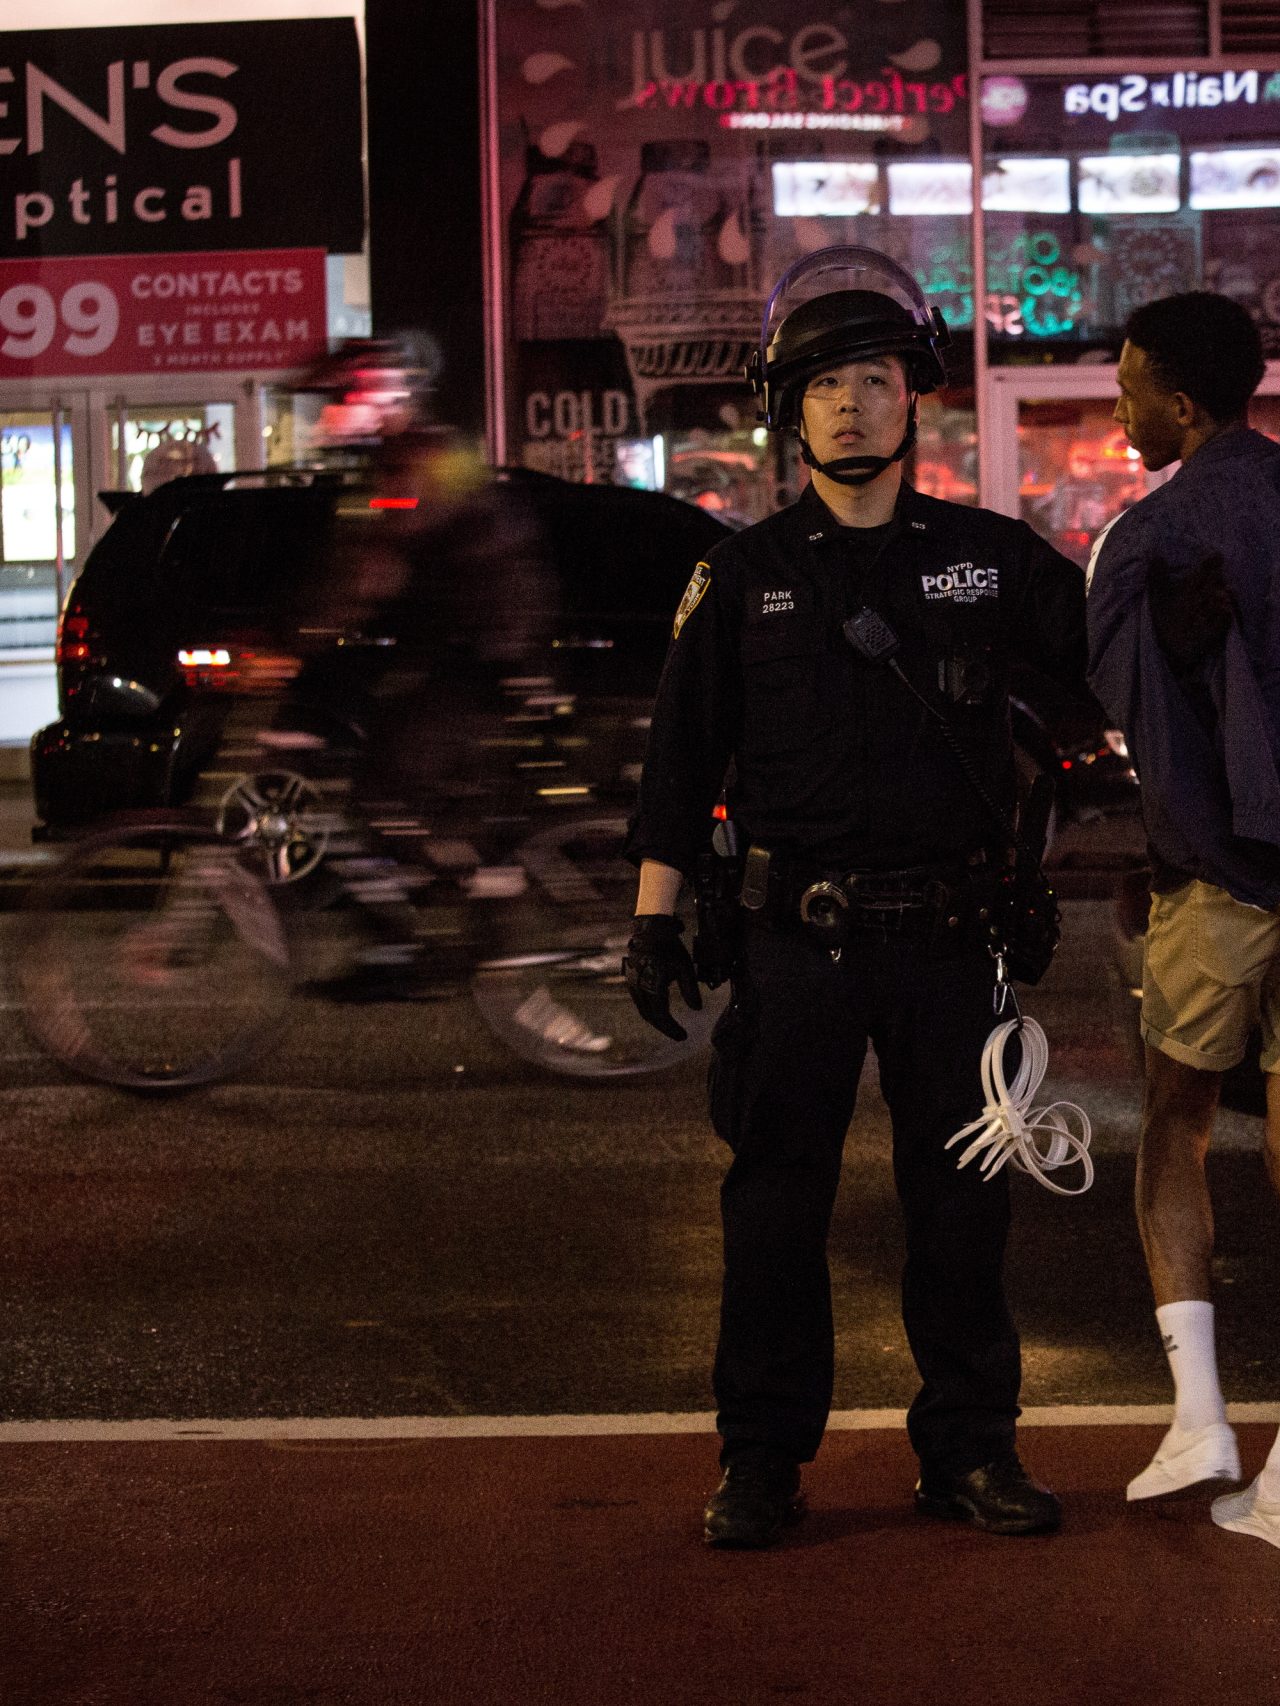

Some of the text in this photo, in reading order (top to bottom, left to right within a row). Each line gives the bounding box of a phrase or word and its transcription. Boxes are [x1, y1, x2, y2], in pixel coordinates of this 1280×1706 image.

[616, 2, 849, 110] juice
[15, 157, 242, 240] ptical
[131, 268, 304, 298] CONTACTS
[138, 323, 201, 347] EYE
[214, 319, 310, 344] EXAM
[526, 389, 630, 438] COLD
[947, 562, 973, 573] NYPD
[921, 568, 998, 592] POLICE
[764, 591, 792, 602] PARK
[925, 589, 965, 600] STRATEGIC
[953, 595, 978, 603] GROUP
[762, 601, 794, 614] 28223
